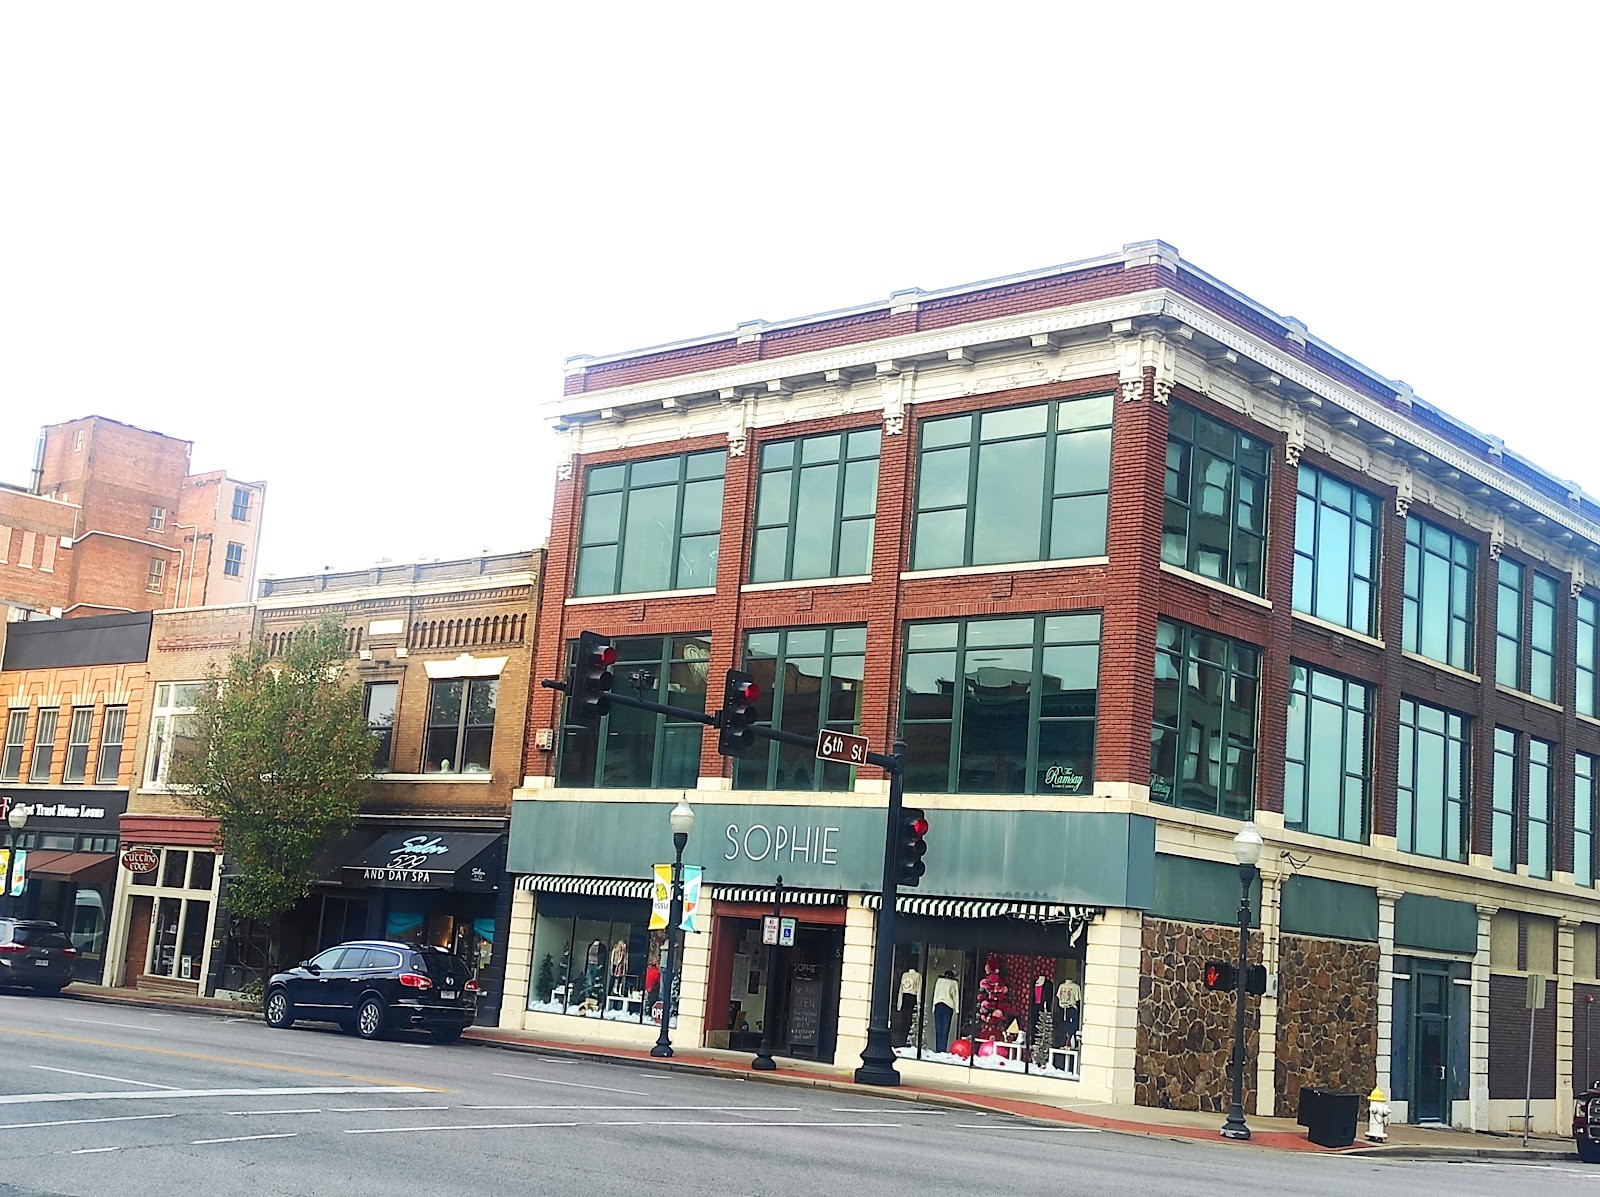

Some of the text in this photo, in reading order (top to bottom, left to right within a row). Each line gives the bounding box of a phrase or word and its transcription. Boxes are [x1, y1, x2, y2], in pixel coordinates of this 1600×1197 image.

[822, 734, 863, 761] 6th St
[1044, 765, 1084, 792] Ramsay
[36, 803, 57, 816] Trust
[56, 803, 80, 817] Home
[80, 804, 105, 818] Loans
[389, 835, 450, 854] Salon
[724, 823, 840, 865] SOPHIE
[386, 854, 428, 870] 529
[363, 868, 430, 883] AND DAY SPA
